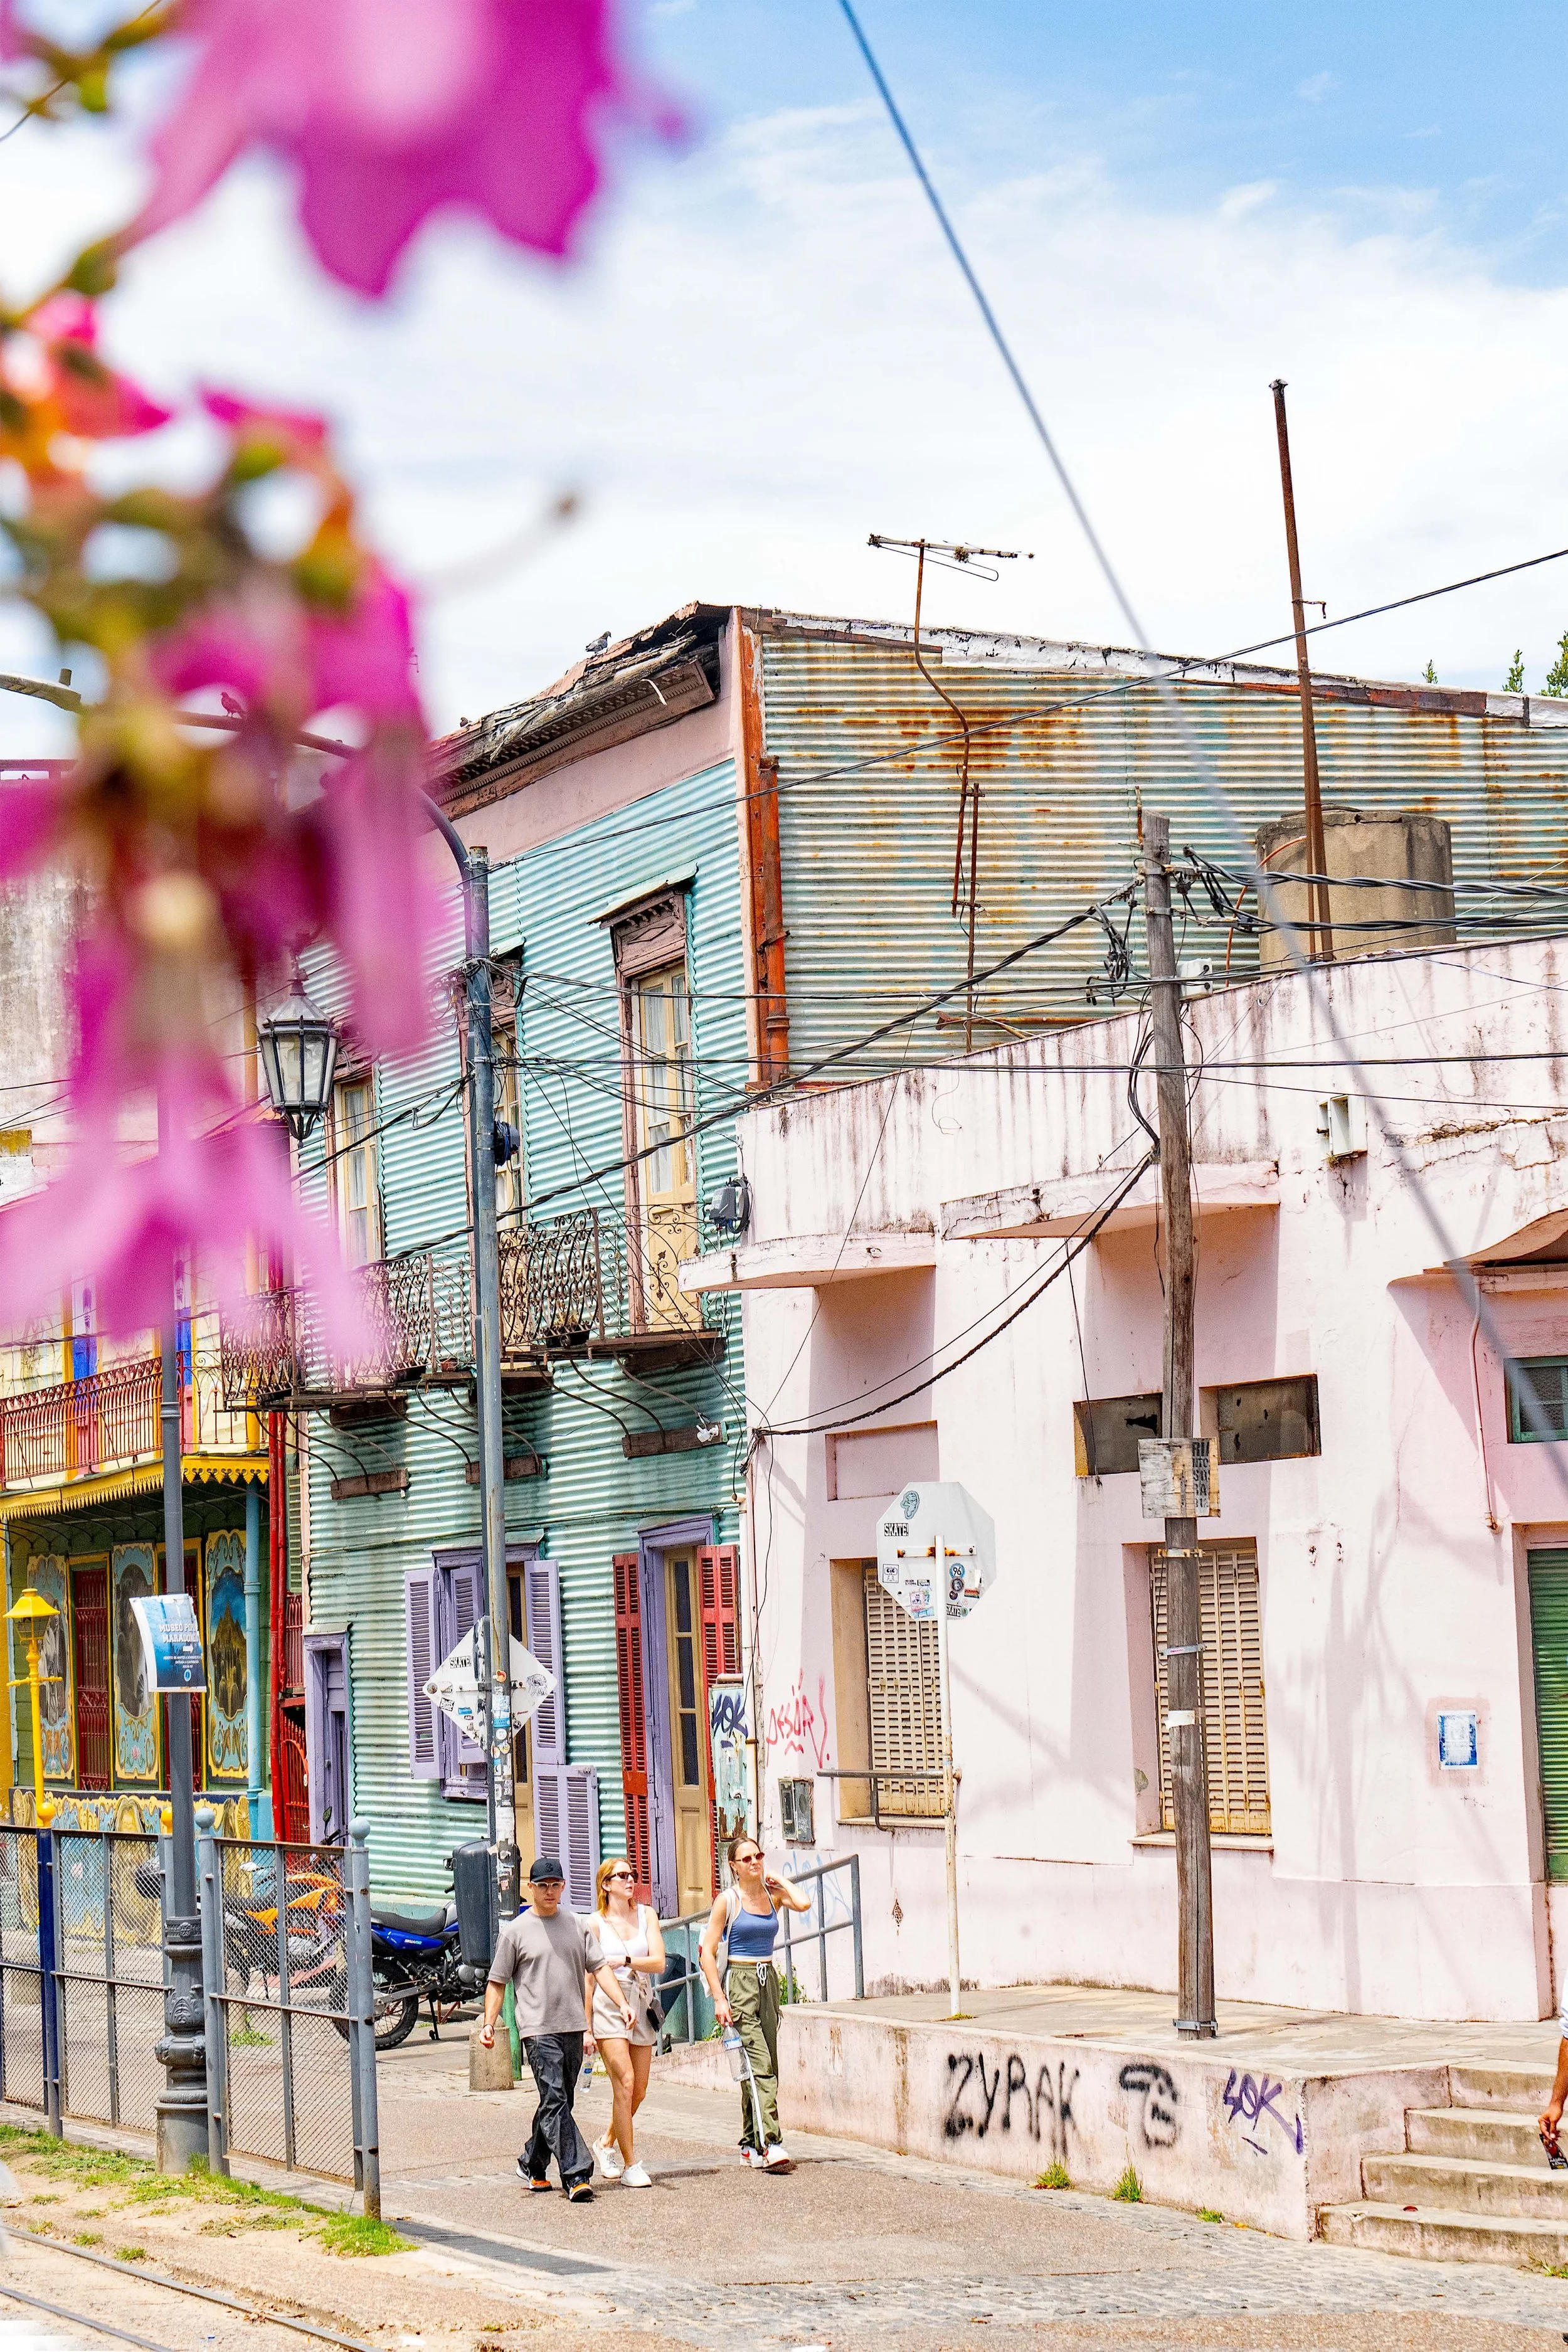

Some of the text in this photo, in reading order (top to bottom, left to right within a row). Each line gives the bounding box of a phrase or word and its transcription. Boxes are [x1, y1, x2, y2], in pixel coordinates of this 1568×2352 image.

[884, 1523, 909, 1536] SKATE!
[953, 1567, 961, 1576] 96
[159, 1623, 184, 1633] MUSEO
[450, 1656, 472, 1668] SKATE!
